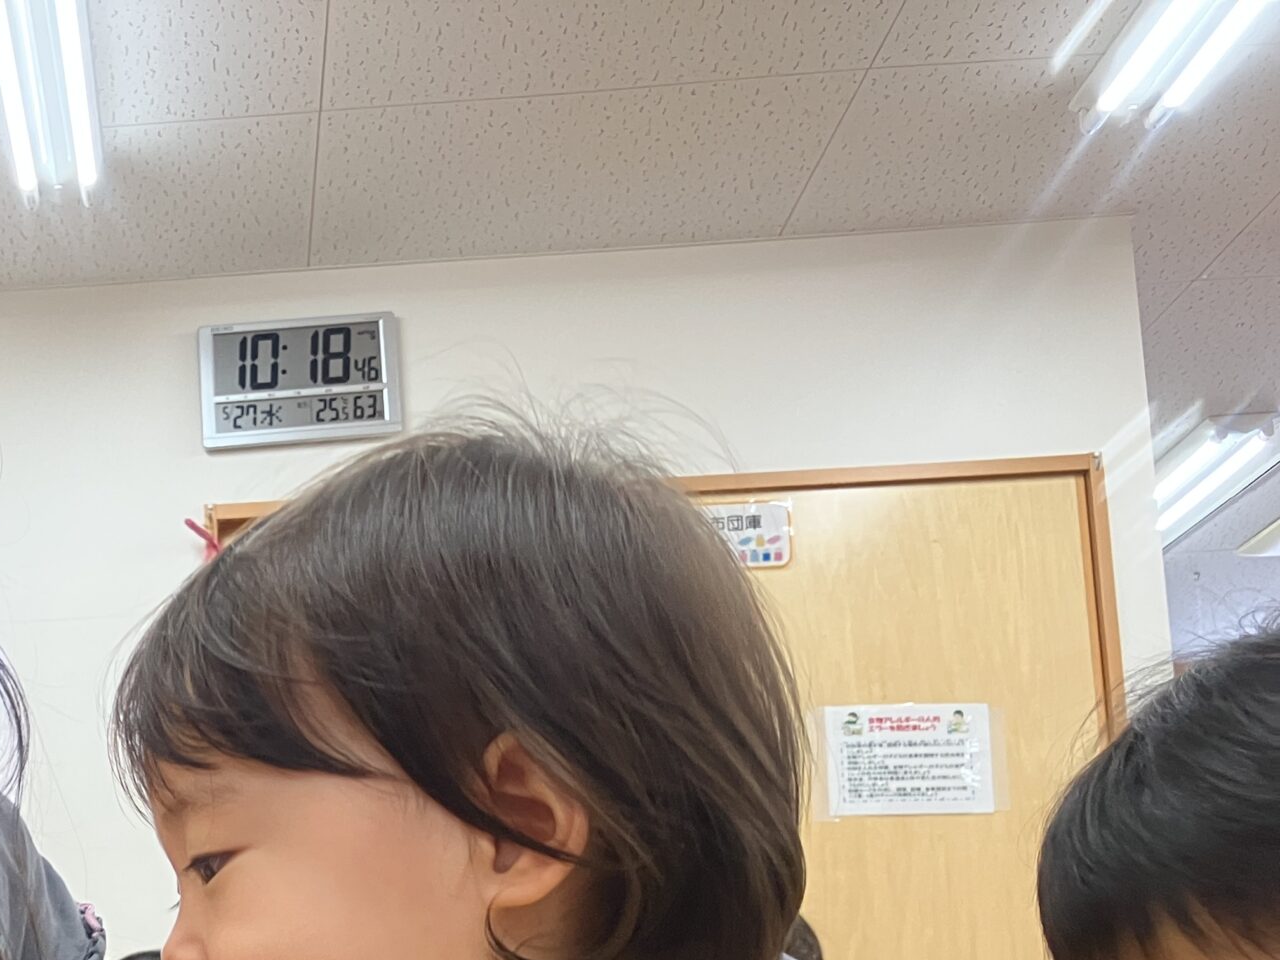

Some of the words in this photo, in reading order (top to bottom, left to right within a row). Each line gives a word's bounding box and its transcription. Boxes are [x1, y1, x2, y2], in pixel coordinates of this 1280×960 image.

[238, 327, 352, 390] 10:18
[353, 356, 380, 383] 46
[260, 403, 283, 427] 水
[352, 394, 378, 420] 63
